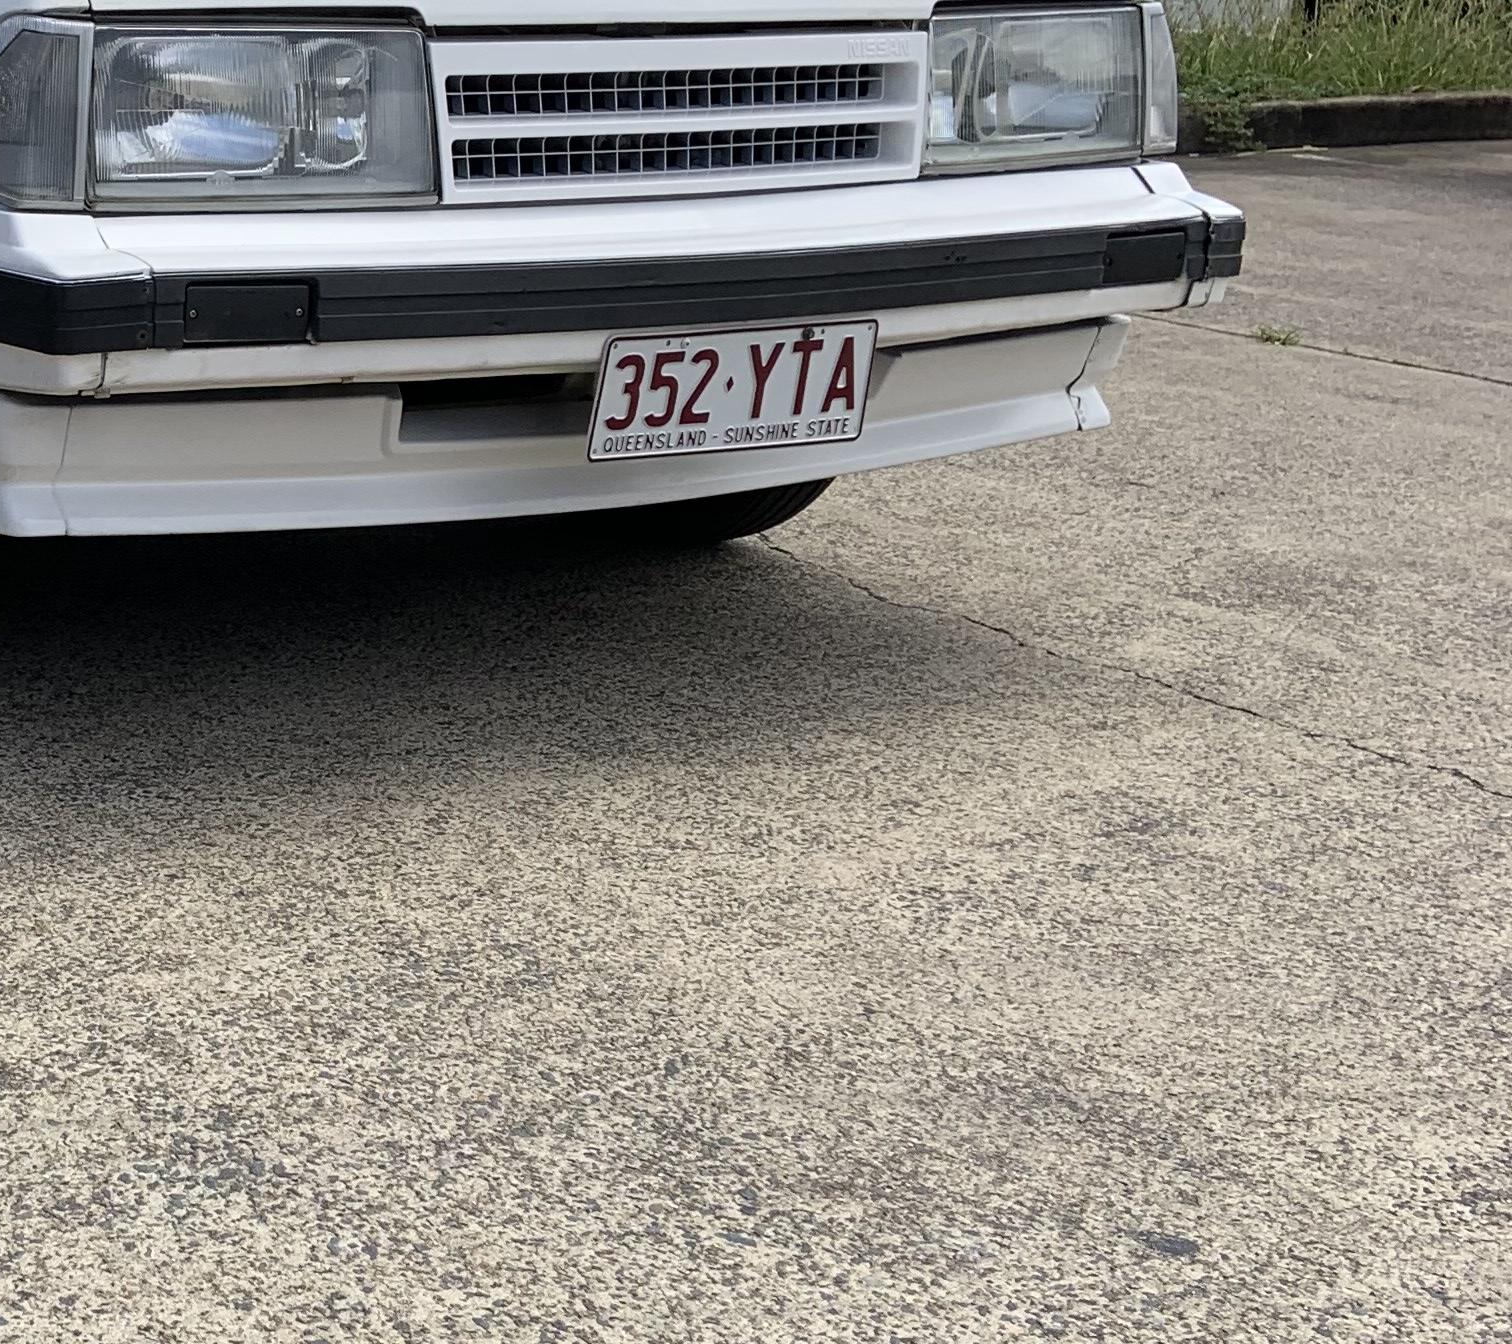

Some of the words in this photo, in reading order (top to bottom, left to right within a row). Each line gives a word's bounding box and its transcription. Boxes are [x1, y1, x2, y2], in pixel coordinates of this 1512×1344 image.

[847, 38, 911, 58] NISSAN
[603, 429, 707, 453] QUEENSLAND
[722, 422, 799, 444] SUNSHINE
[804, 416, 850, 437] STATE
